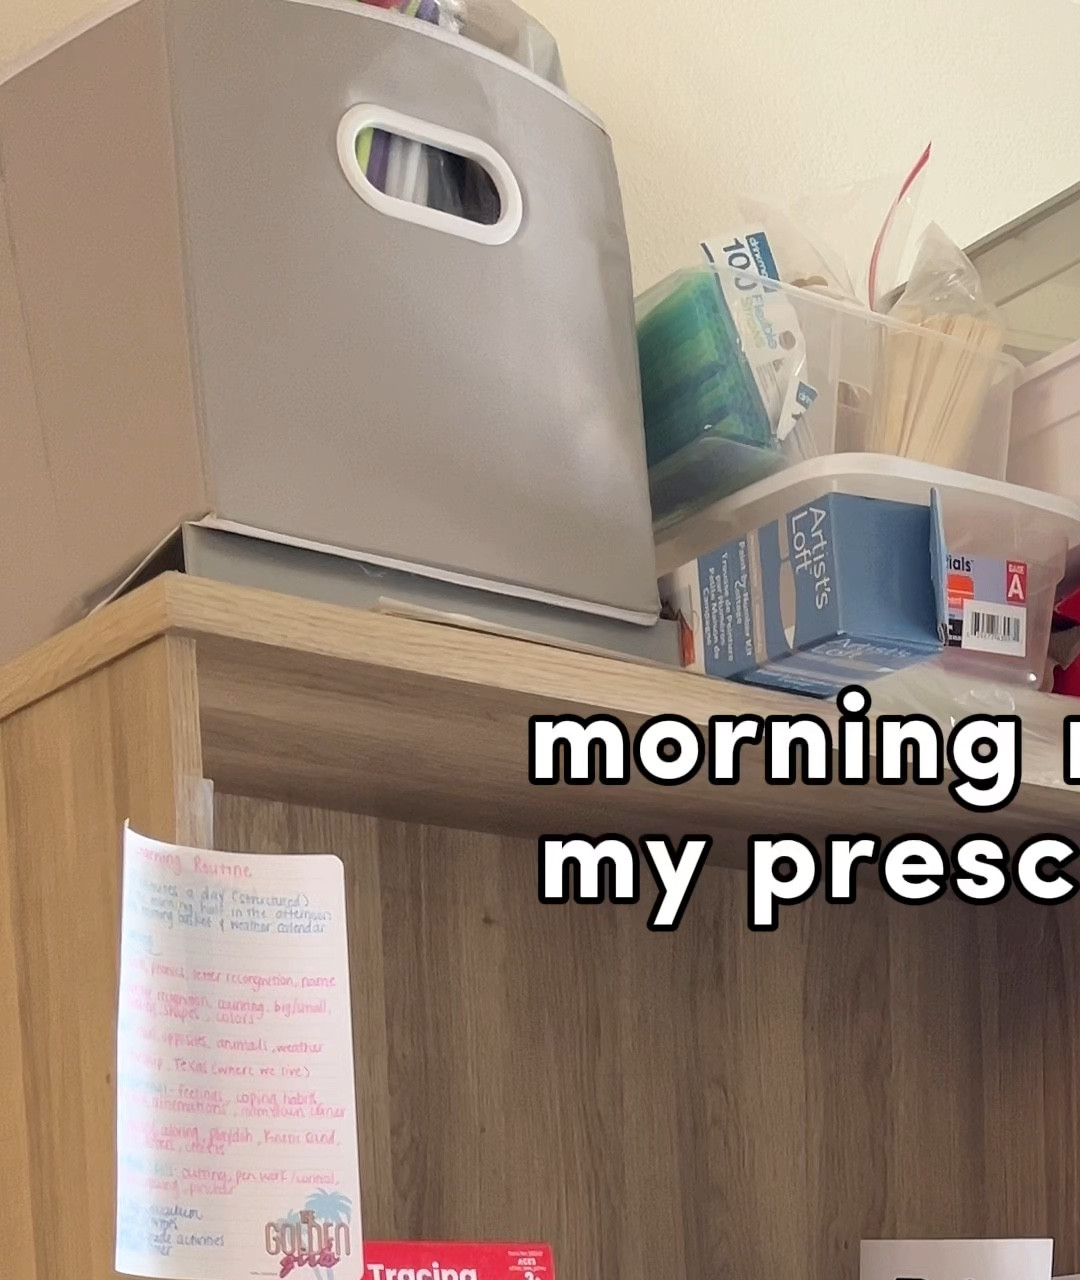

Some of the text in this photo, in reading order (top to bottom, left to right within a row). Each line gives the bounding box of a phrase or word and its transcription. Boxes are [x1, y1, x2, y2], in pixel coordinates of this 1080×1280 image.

[791, 510, 812, 574] Loft
[808, 507, 831, 610] Artist's
[1008, 573, 1024, 600] A
[202, 886, 224, 905] day
[232, 909, 243, 918] in
[246, 908, 267, 919] the
[264, 1221, 351, 1256] GOLDEN
